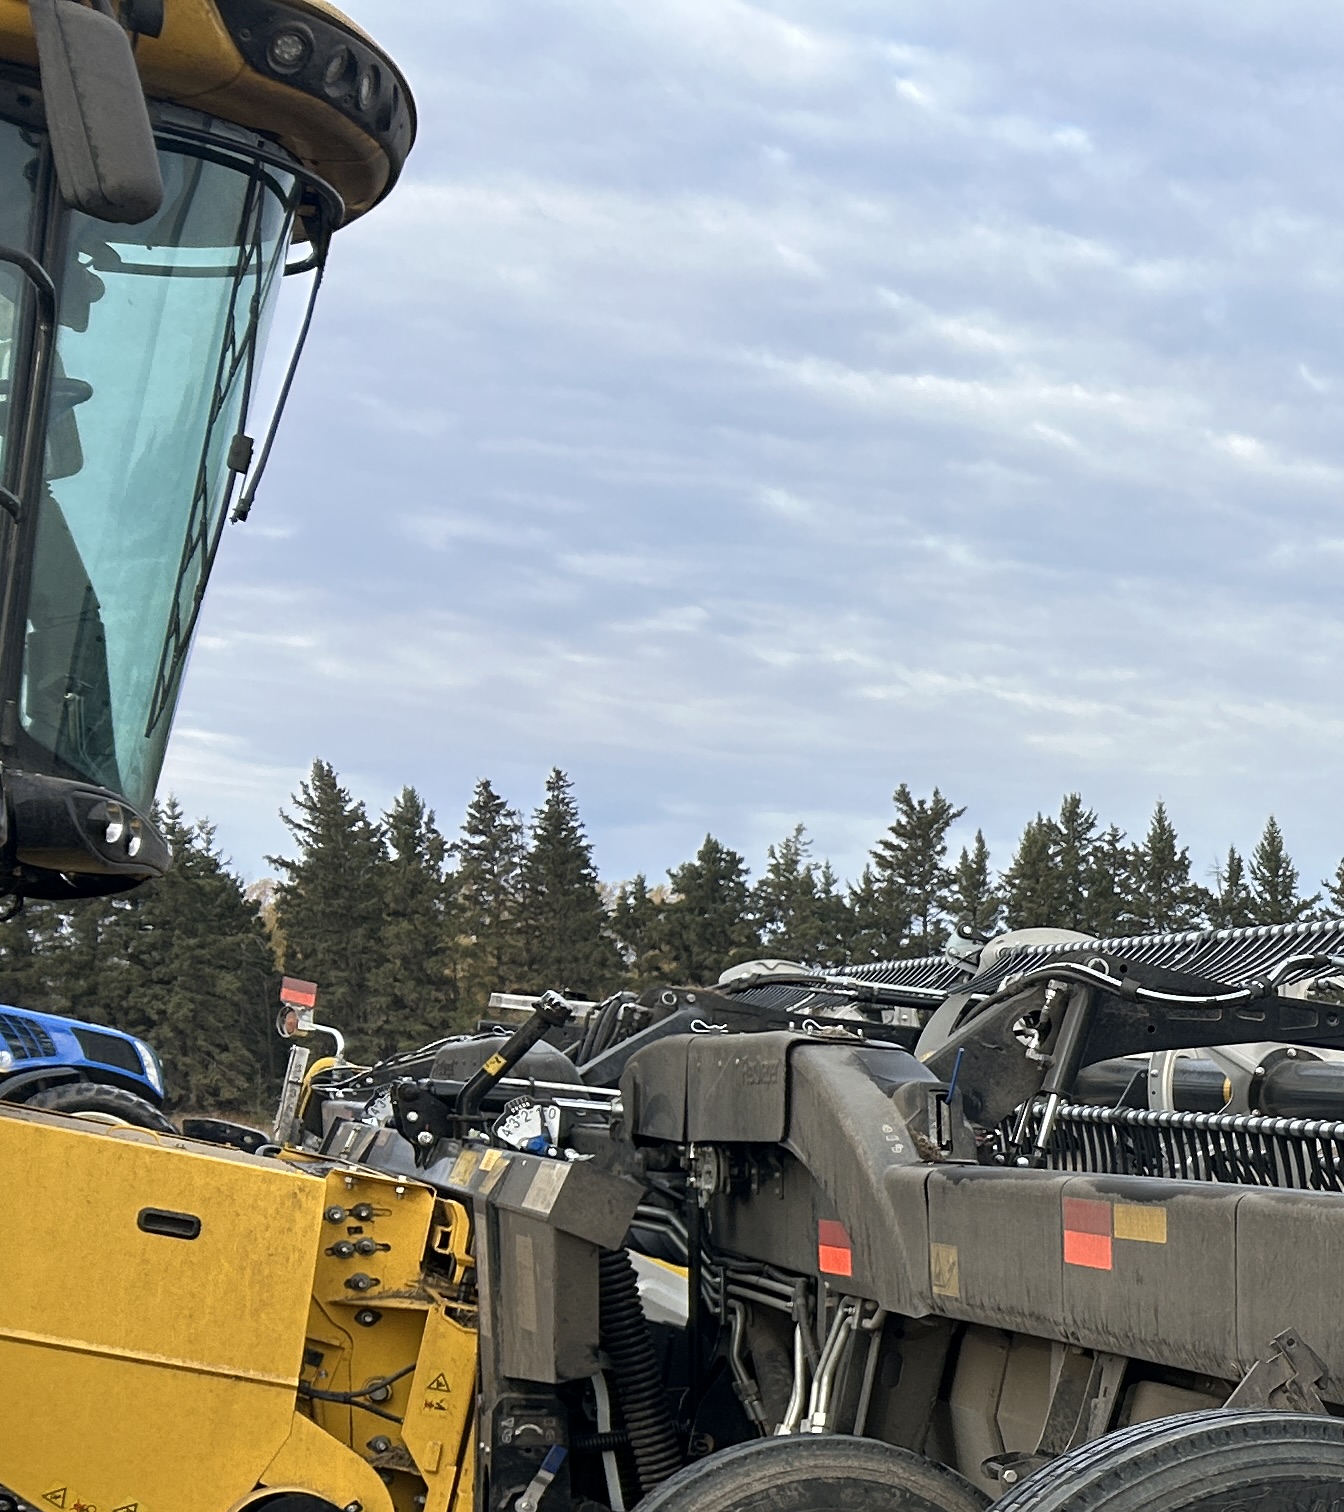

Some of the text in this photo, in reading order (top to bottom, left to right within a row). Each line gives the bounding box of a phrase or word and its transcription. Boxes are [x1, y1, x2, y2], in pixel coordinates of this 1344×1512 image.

[509, 1118, 521, 1129] 3
[521, 1110, 532, 1123] 2
[548, 1107, 557, 1120] 0
